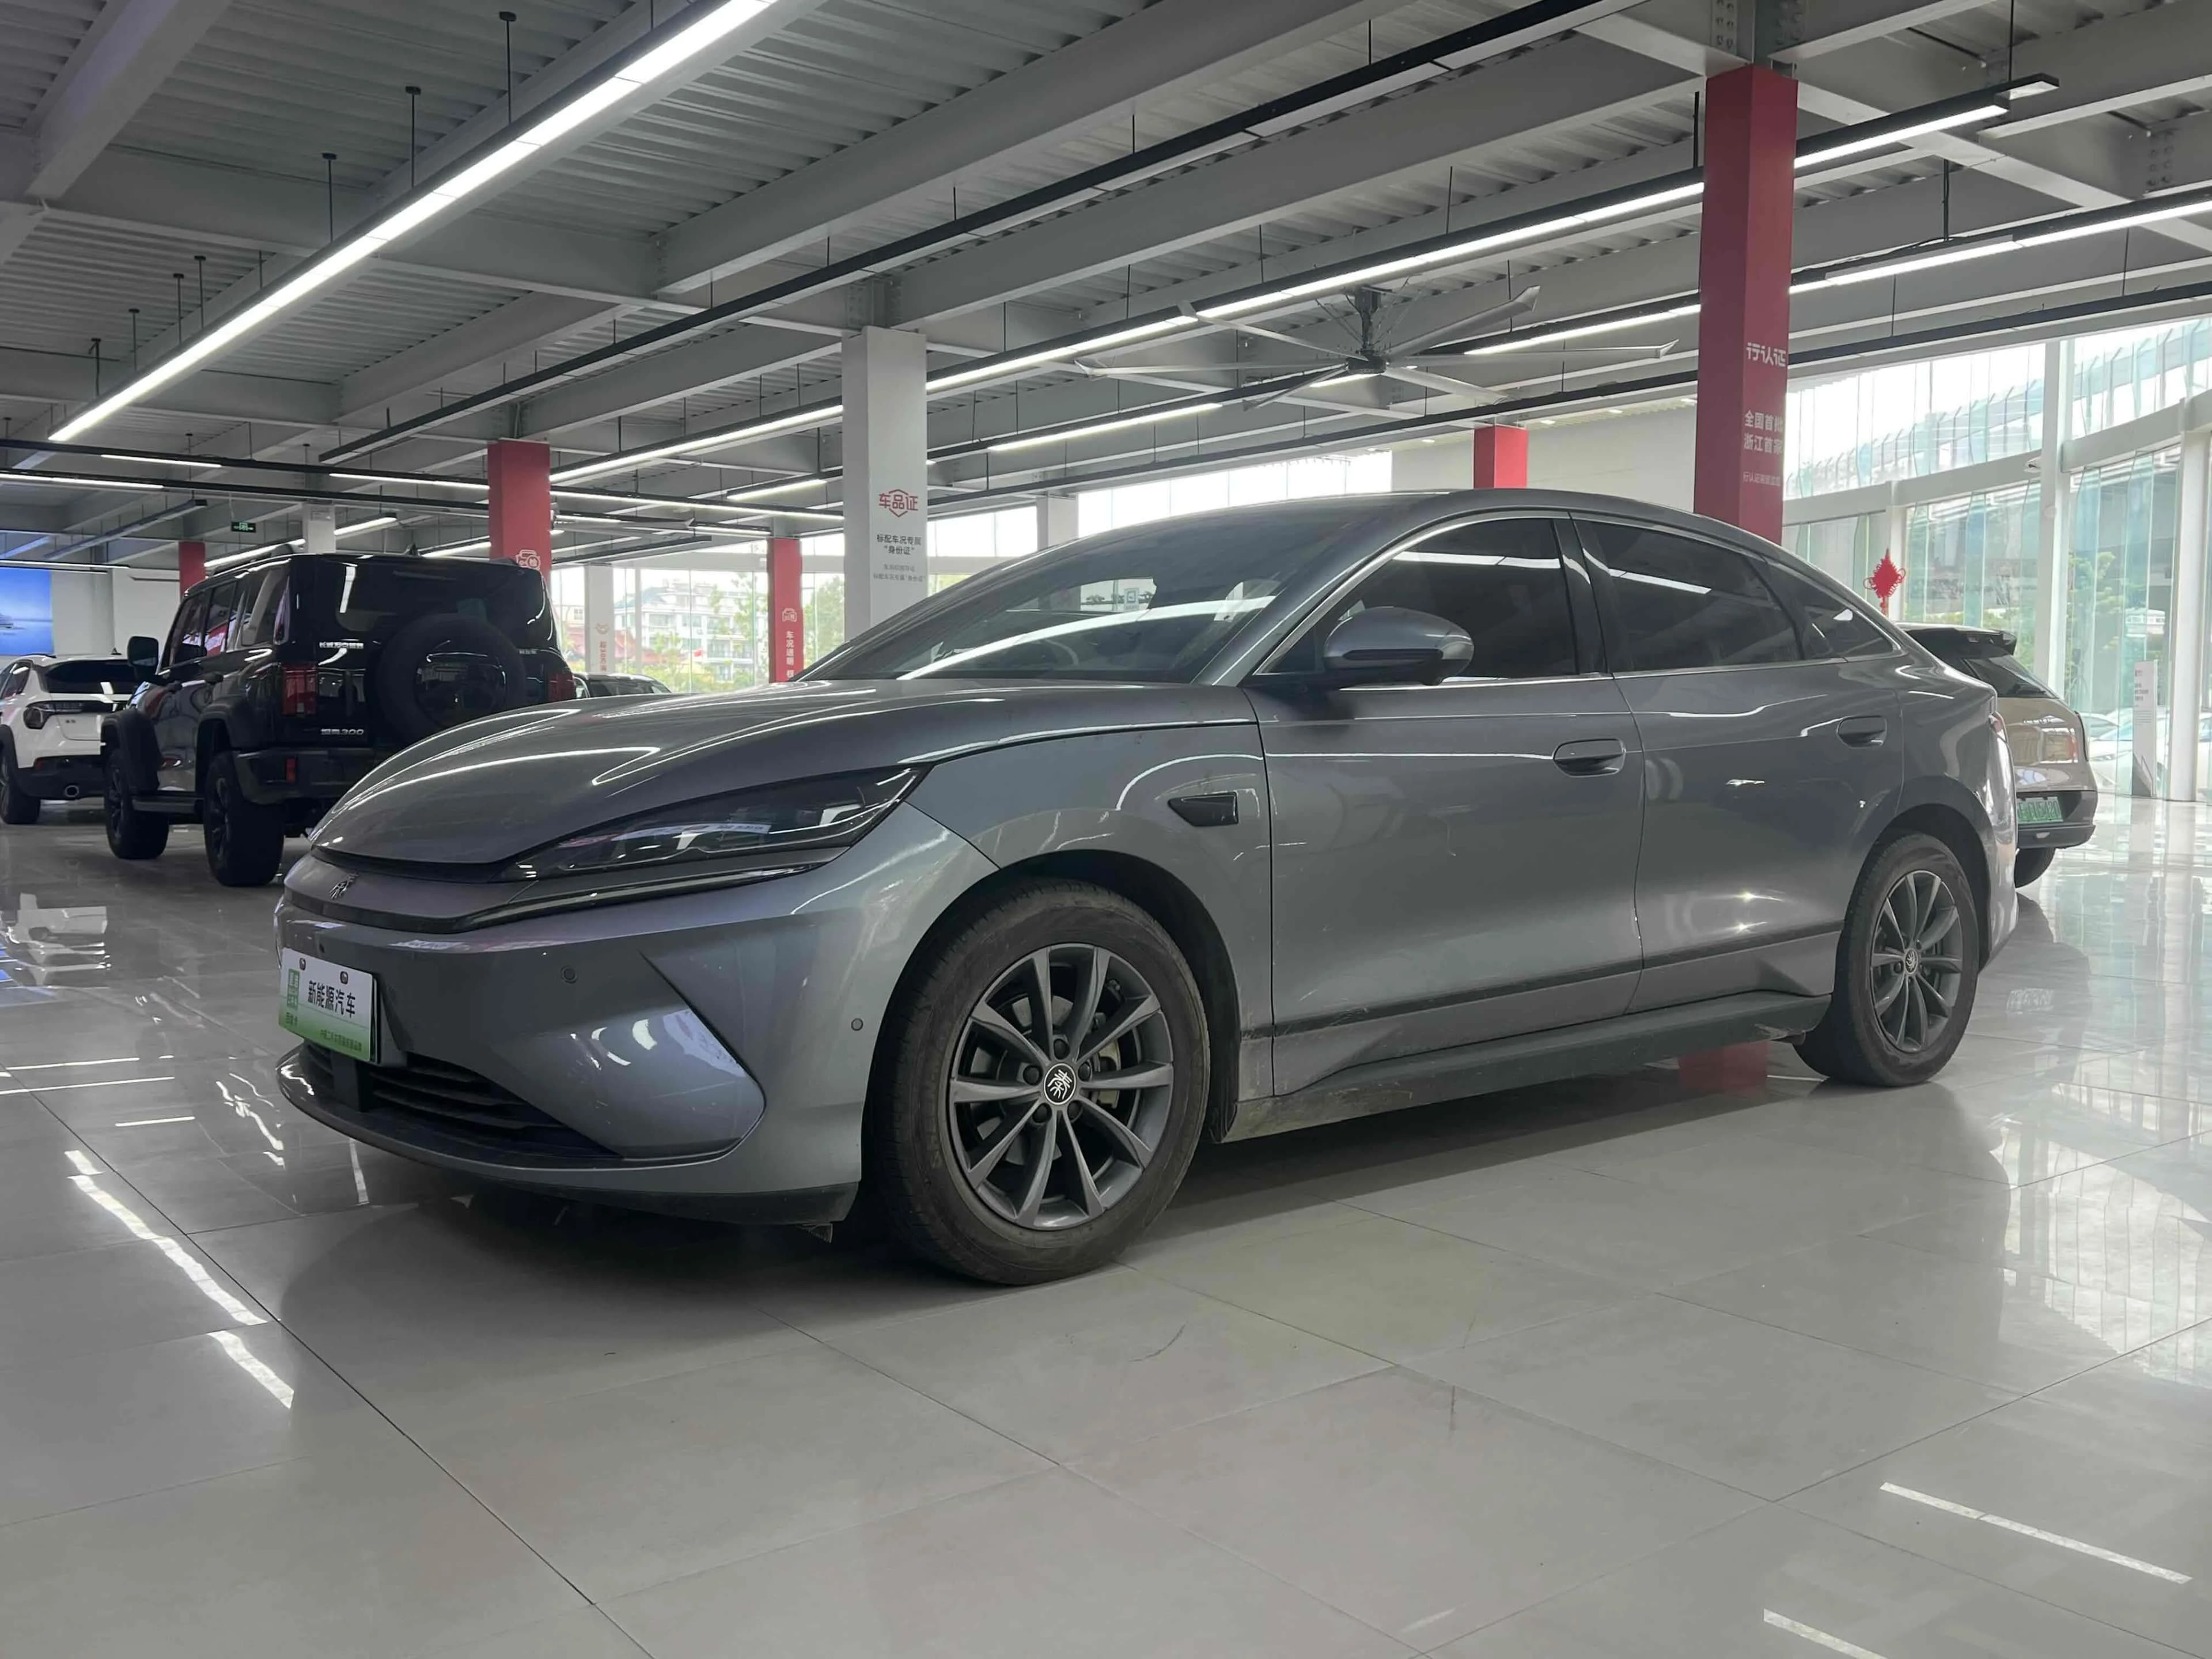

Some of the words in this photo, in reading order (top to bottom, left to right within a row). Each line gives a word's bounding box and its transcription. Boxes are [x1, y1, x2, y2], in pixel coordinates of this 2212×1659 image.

[1747, 342, 1786, 367] 行认证
[308, 980, 355, 1018] 新能源汽车
